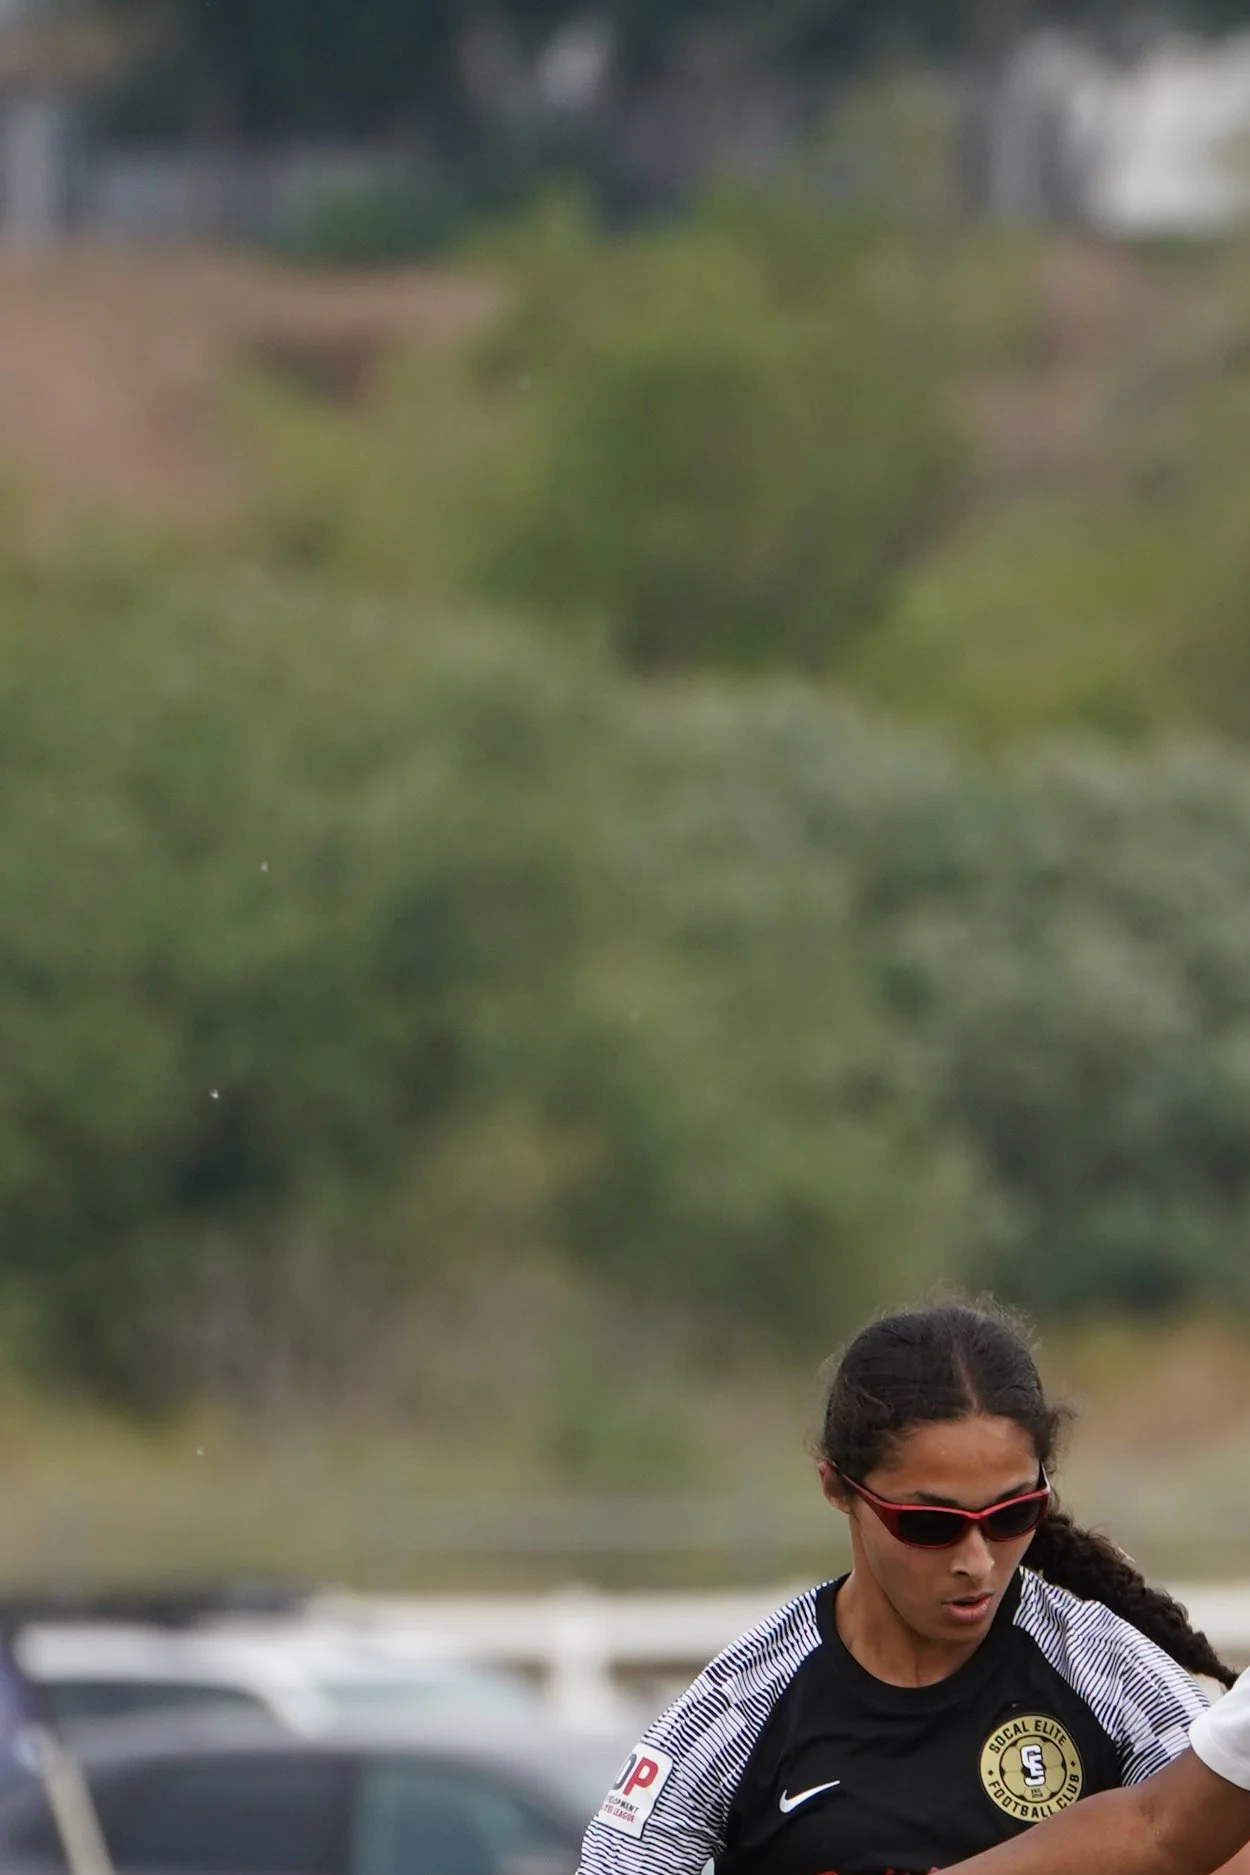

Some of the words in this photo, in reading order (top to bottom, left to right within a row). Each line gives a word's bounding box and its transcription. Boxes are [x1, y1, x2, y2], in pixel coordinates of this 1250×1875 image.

[988, 1720, 1030, 1754] SOCAL
[1034, 1720, 1067, 1746] ELITE
[988, 1780, 1054, 1819] FOOTBALL
[1056, 1774, 1080, 1810] CLUB
